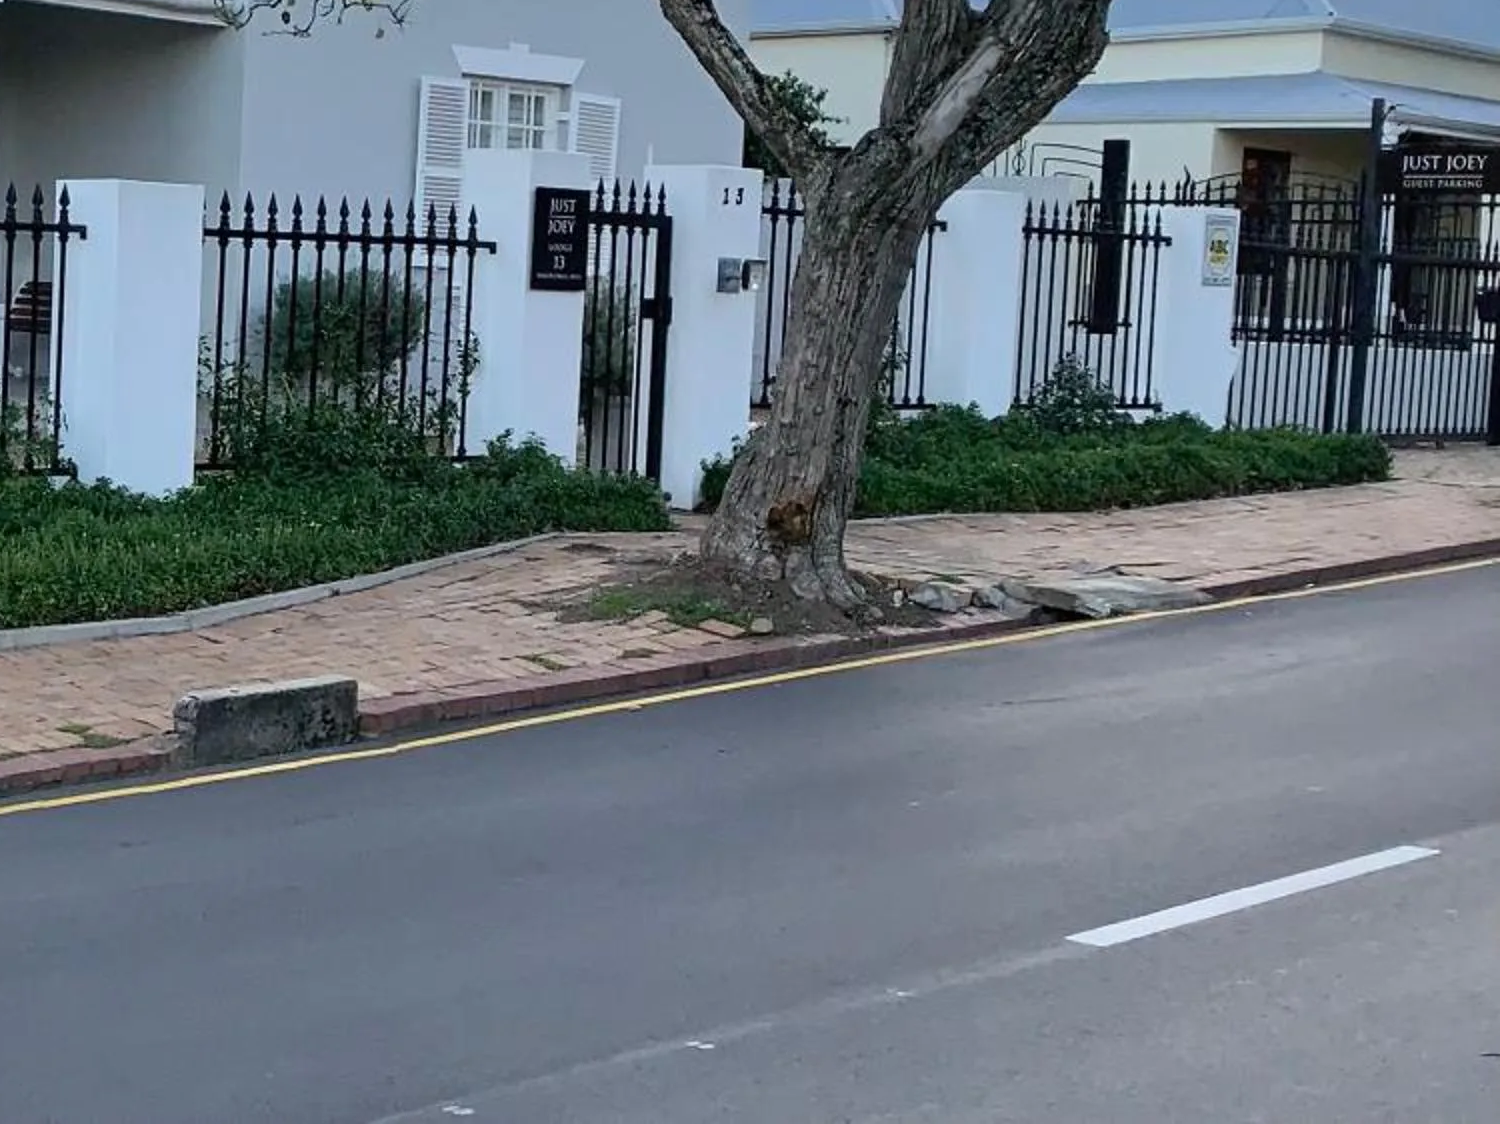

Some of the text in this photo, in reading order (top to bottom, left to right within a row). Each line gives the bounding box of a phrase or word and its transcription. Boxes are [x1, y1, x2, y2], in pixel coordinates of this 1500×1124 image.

[1402, 155, 1488, 172] JUST JOEY
[1403, 179, 1483, 189] GUEST PARKING
[550, 198, 577, 215] JUST
[548, 219, 576, 236] JOEY
[553, 255, 566, 270] 13
